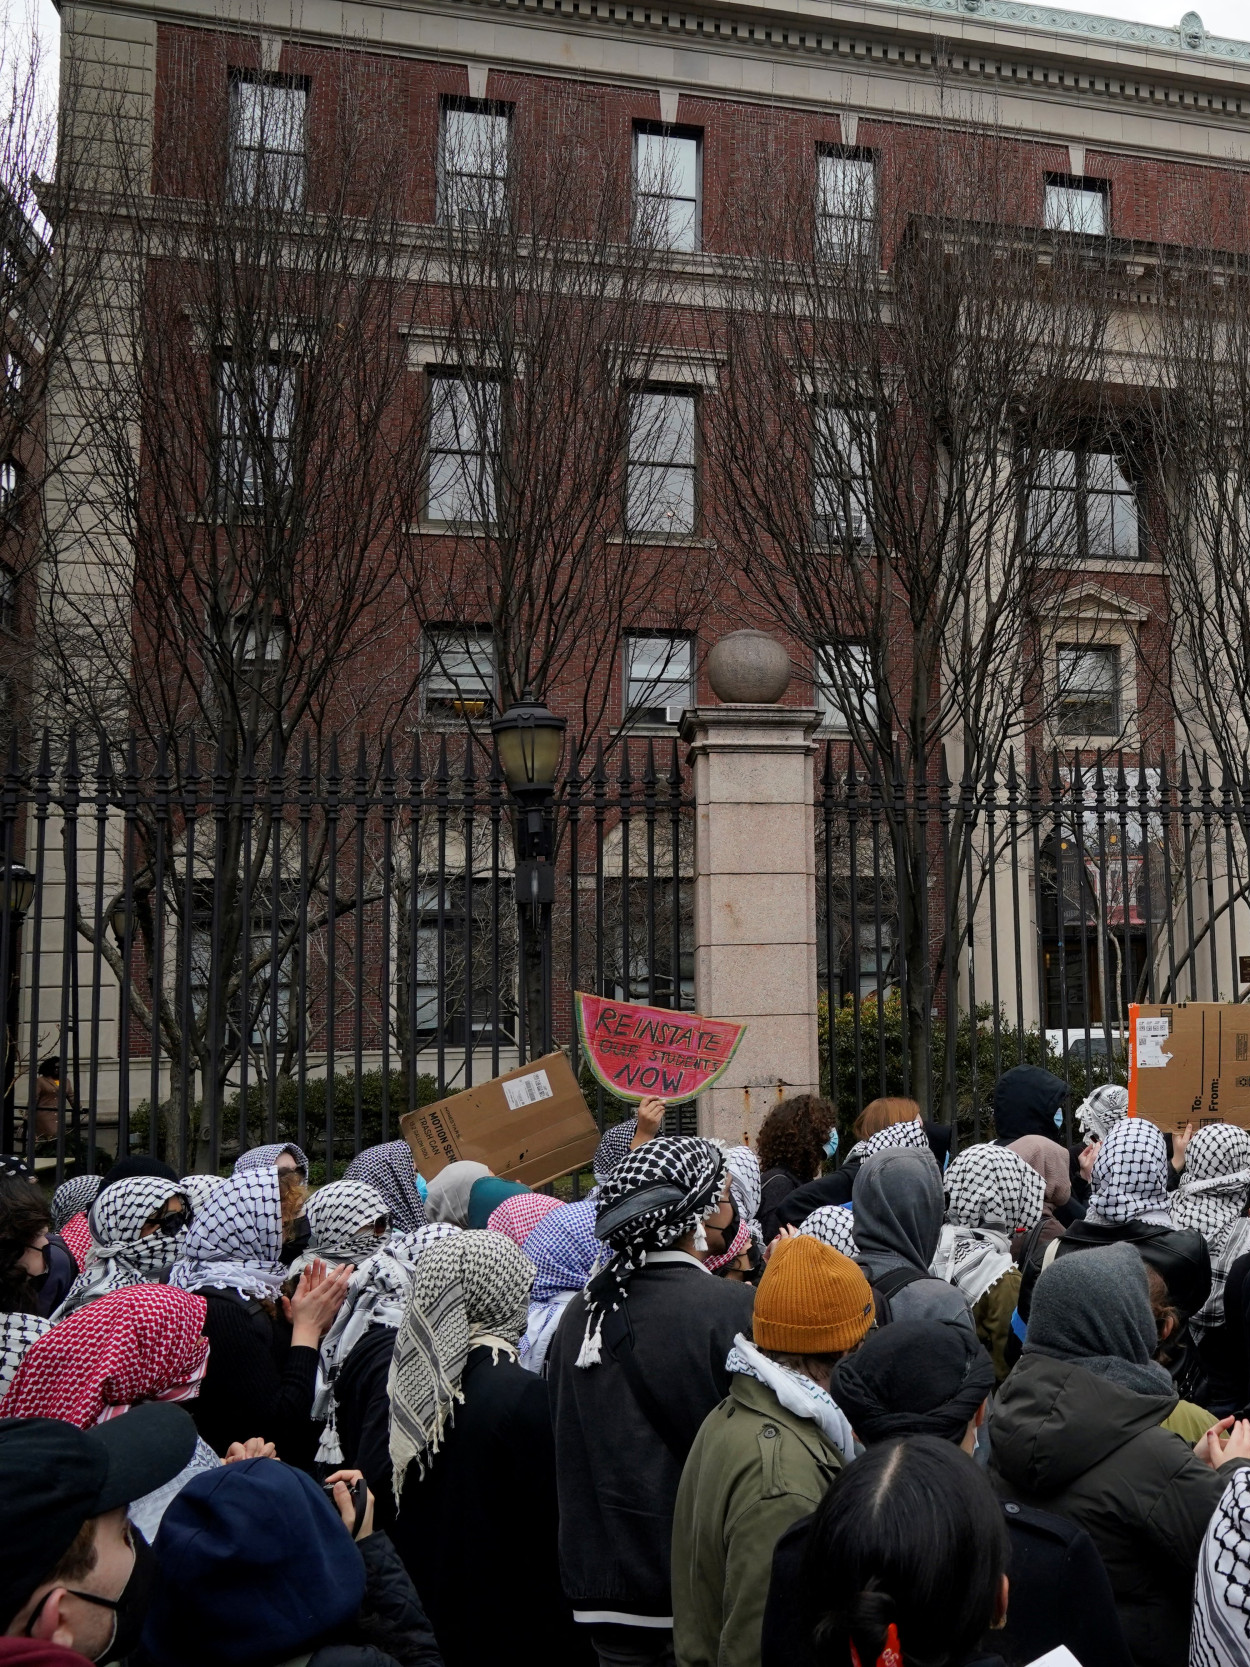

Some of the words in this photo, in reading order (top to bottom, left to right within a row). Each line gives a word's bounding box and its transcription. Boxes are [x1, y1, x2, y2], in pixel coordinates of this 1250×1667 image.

[595, 1007, 723, 1052] REINSTATE
[599, 1038, 639, 1060] OUR
[648, 1049, 724, 1072] STUDENTS
[613, 1063, 684, 1094] NOW
[1208, 1078, 1219, 1112] From:
[1191, 1095, 1202, 1113] To:
[420, 1116, 433, 1141] TRASH
[429, 1139, 441, 1156] CAN
[429, 1111, 449, 1144] MOTION
